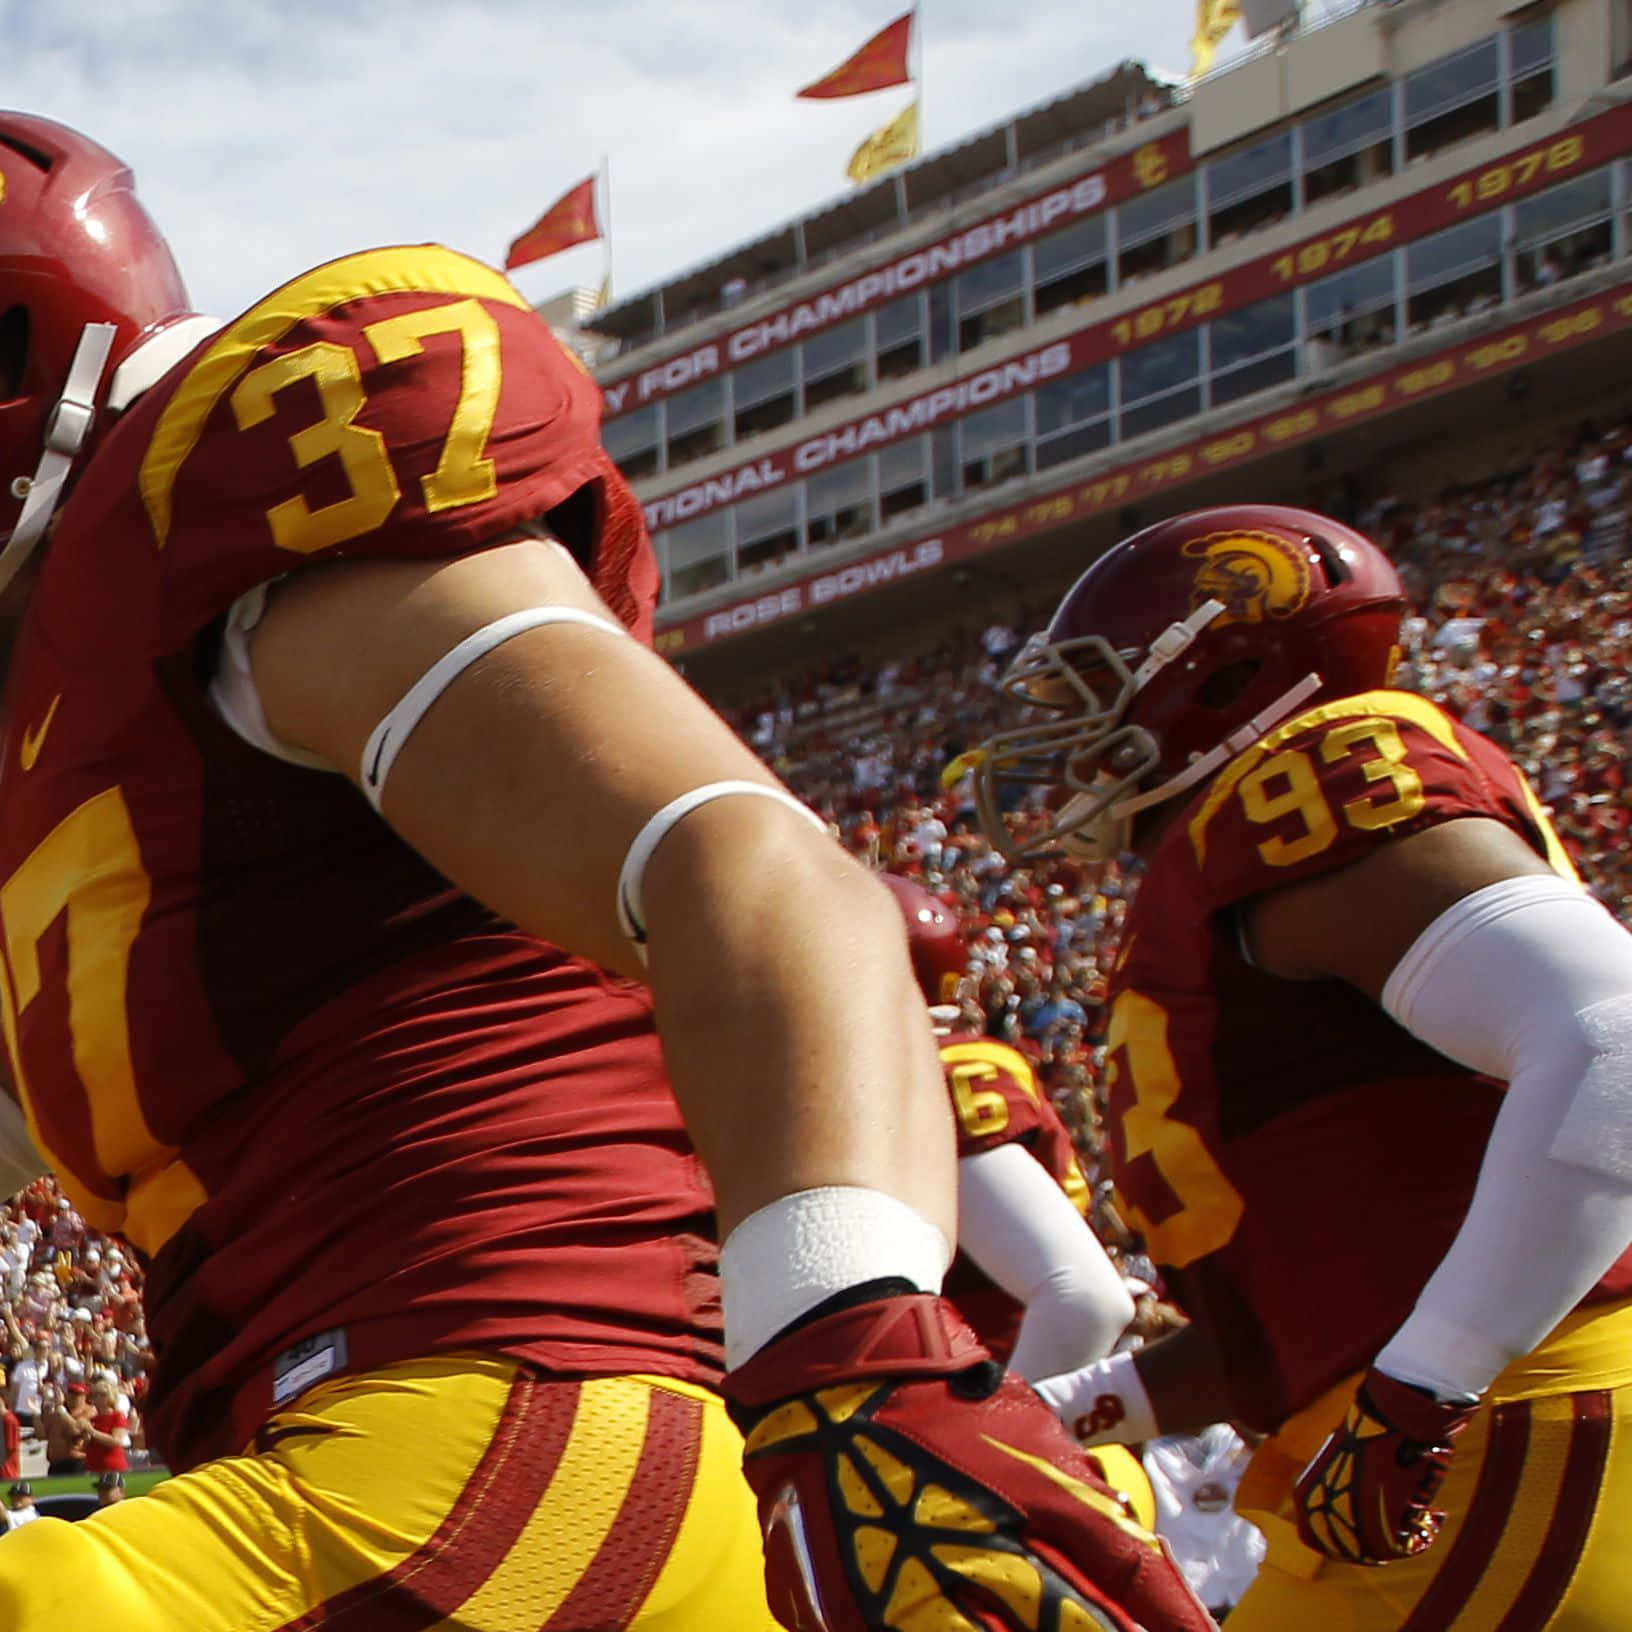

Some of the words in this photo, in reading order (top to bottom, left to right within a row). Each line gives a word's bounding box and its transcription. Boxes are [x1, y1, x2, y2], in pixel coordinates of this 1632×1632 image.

[640, 343, 720, 400] FOR
[729, 176, 1107, 360] CHAMPIONSHIPS
[645, 460, 785, 527] TIONAL
[794, 343, 1072, 472] CHAMPIONS
[1110, 283, 1224, 345] 1972
[1271, 213, 1396, 281] 1974
[1446, 135, 1585, 209] 1978
[229, 297, 504, 556] 37
[705, 588, 802, 638] ROSE
[810, 538, 943, 604] BOWLS
[1237, 716, 1427, 868] 93
[1106, 988, 1246, 1270] 3
